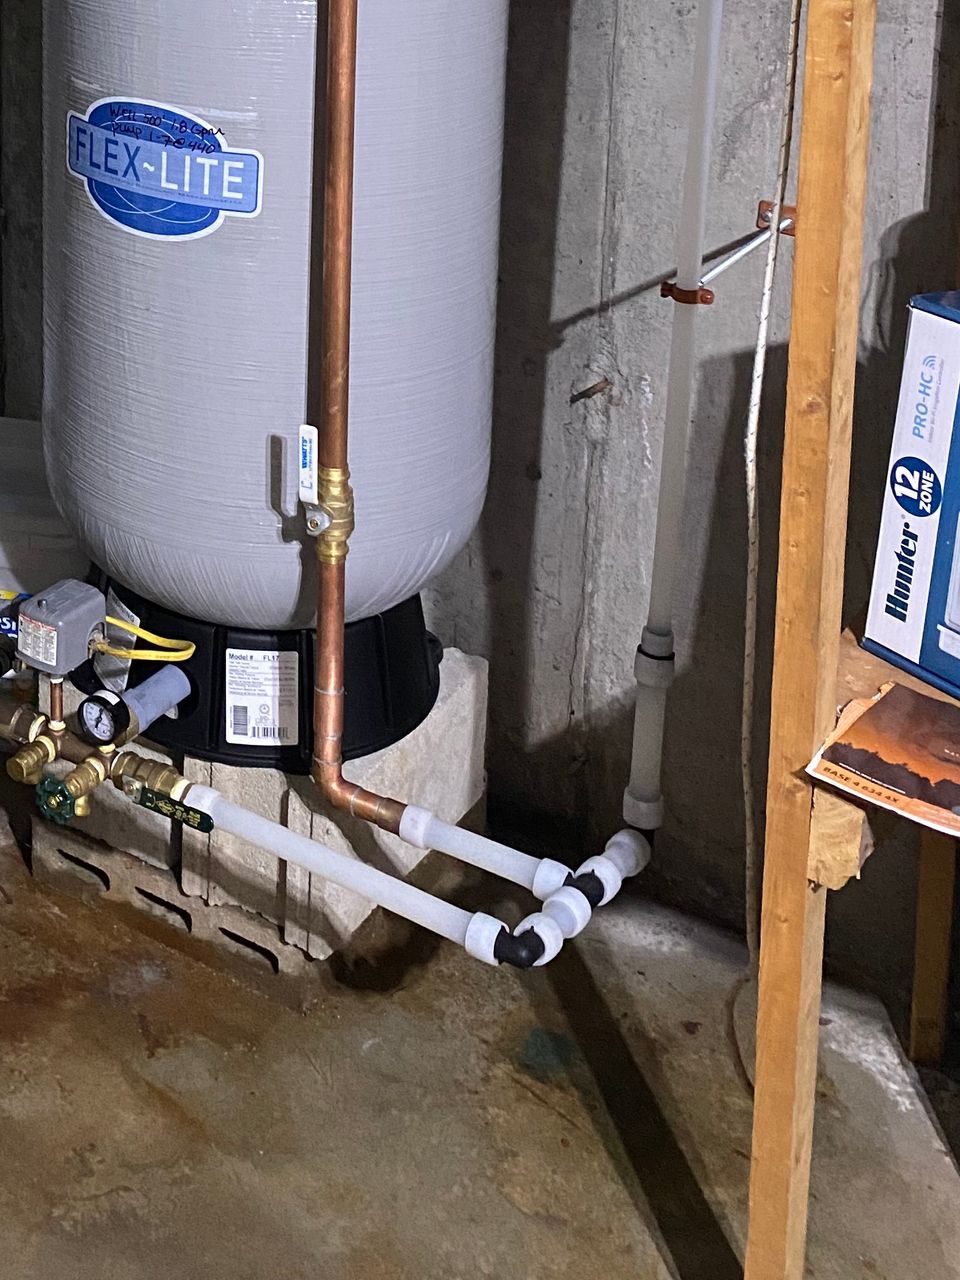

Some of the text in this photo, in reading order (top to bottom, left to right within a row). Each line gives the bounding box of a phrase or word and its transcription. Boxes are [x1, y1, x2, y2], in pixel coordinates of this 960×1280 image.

[912, 370, 934, 440] PRO-HC
[894, 465, 920, 500] 12
[918, 470, 935, 513] ZONE
[884, 522, 919, 623] Hunter
[823, 766, 850, 782] BASE
